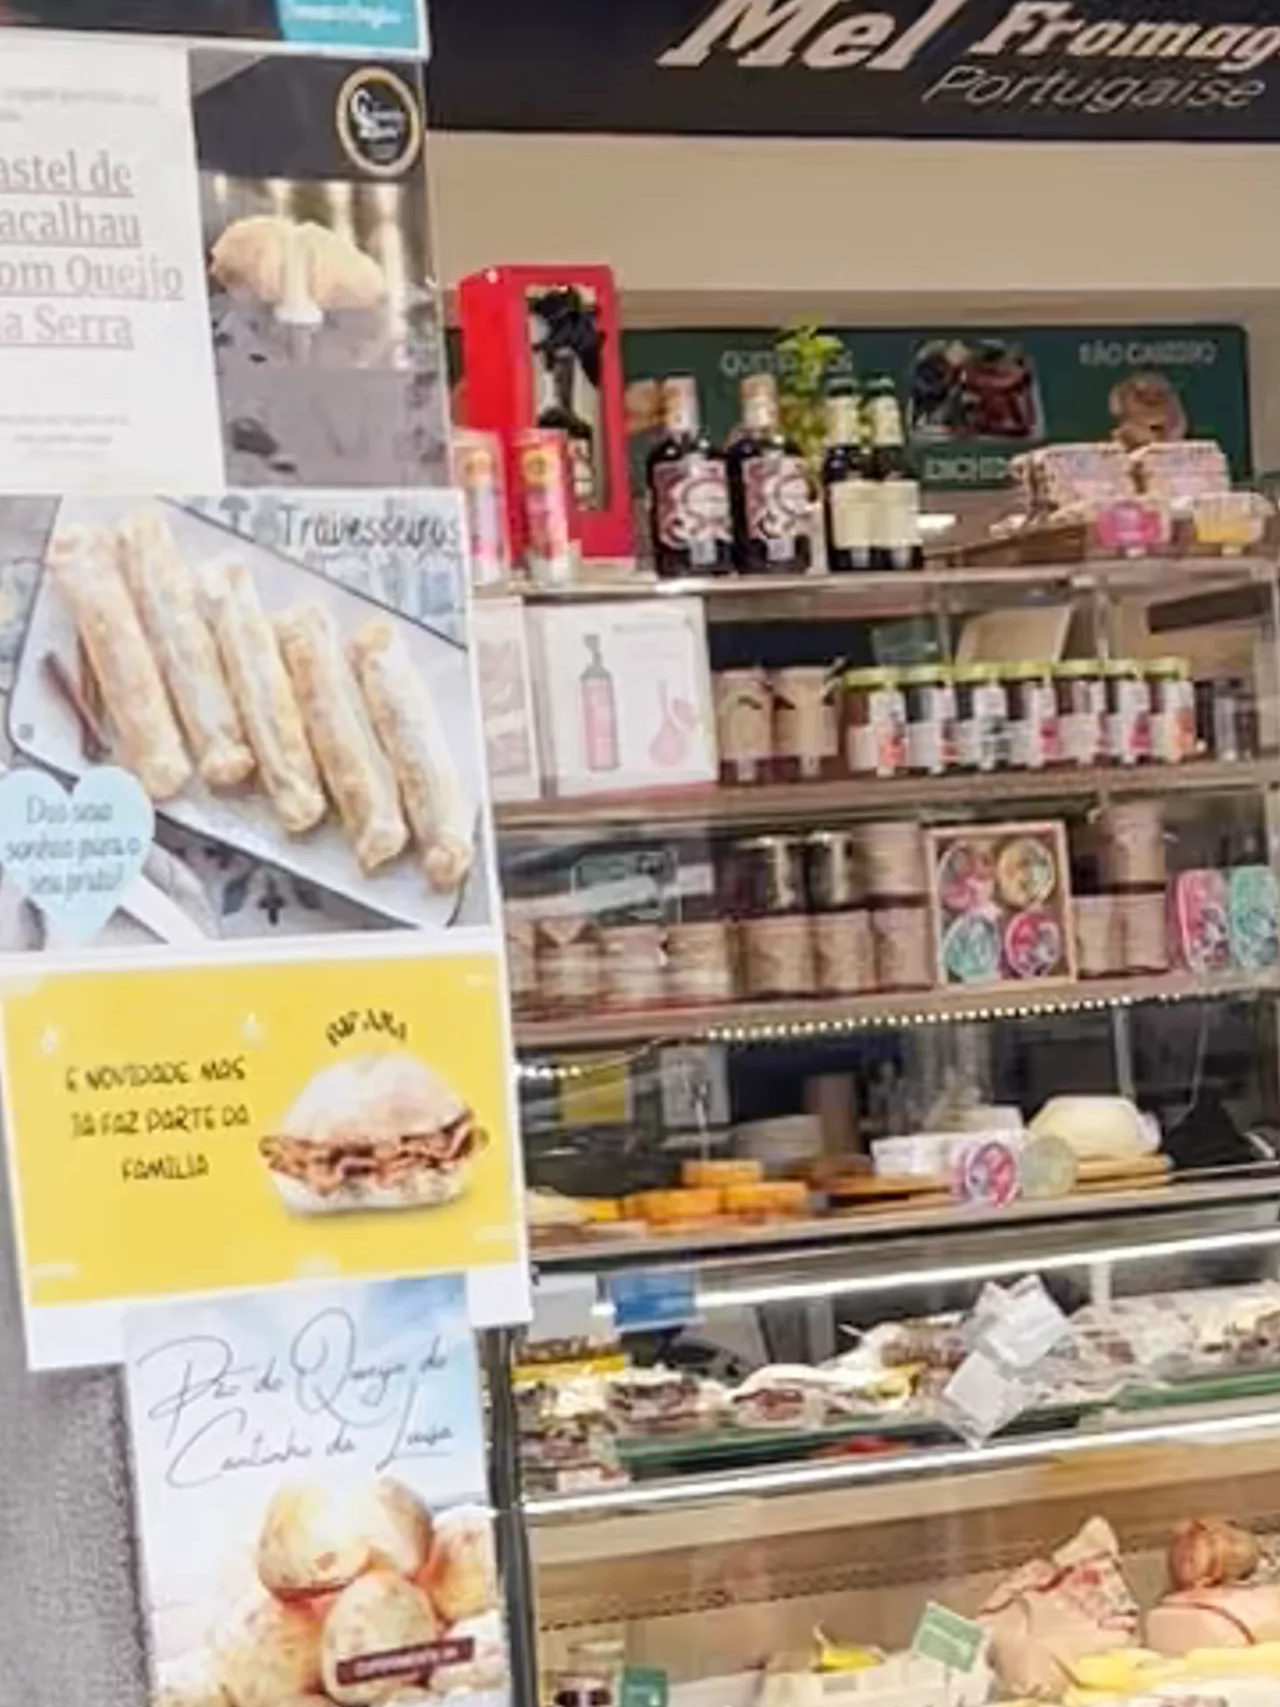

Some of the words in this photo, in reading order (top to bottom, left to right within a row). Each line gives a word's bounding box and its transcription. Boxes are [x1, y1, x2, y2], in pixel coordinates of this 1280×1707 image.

[923, 64, 1267, 113] Portugaise
[90, 149, 133, 197] de
[66, 253, 184, 301] Queijo
[34, 303, 134, 345] Serra
[85, 1060, 190, 1091] NOVIDADE
[200, 1055, 246, 1081] MAS
[145, 1104, 216, 1133] PARTE
